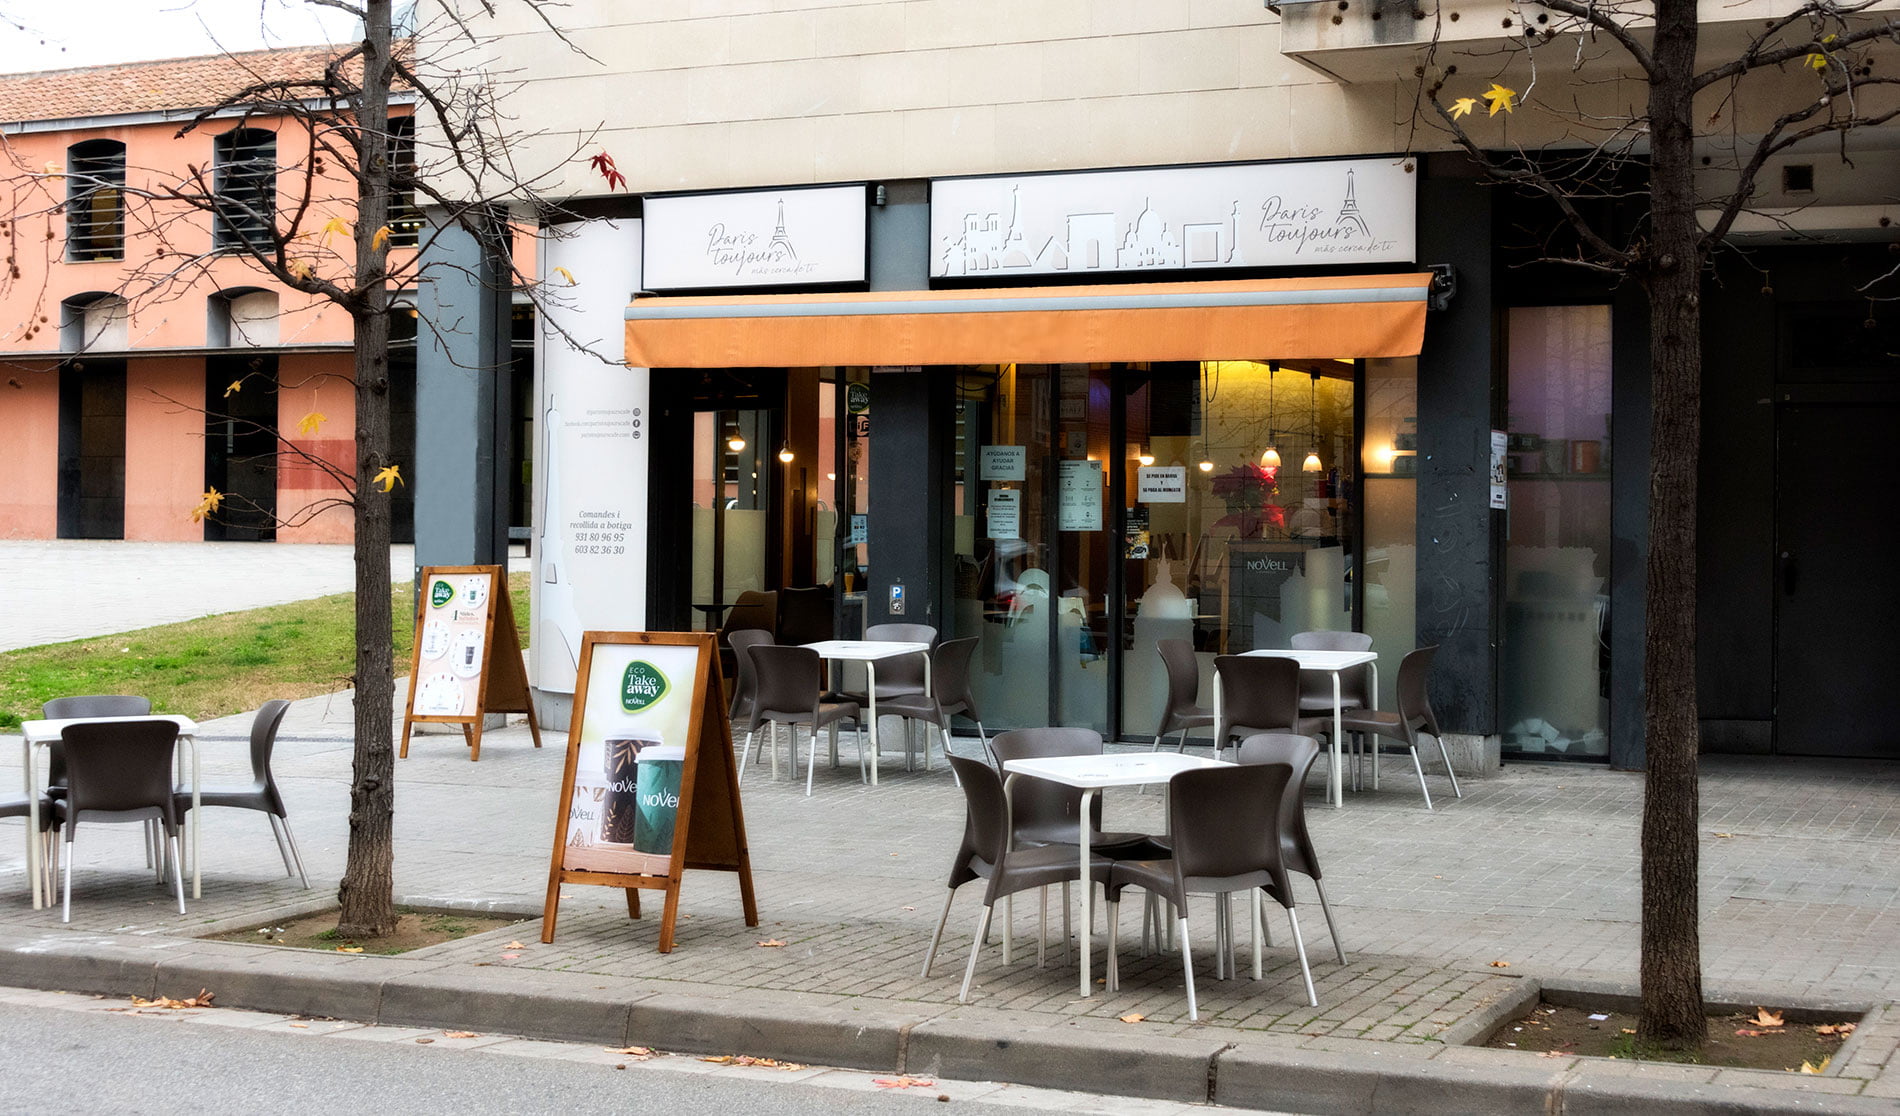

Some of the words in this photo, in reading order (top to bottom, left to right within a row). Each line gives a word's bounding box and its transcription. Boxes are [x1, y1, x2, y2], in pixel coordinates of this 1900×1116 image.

[1260, 195, 1323, 231] Paris
[707, 223, 758, 255] Paris
[1264, 221, 1357, 254] toujours
[711, 246, 786, 275] toujours
[578, 510, 616, 519] Comandes
[616, 510, 621, 519] i
[569, 520, 599, 529] recollida
[606, 521, 633, 531] botiga
[575, 532, 588, 542] 931
[589, 532, 600, 542] 80
[600, 533, 612, 542] 96
[613, 532, 625, 542] 95
[574, 545, 588, 554] 603
[589, 545, 600, 554] 82
[600, 545, 612, 555] 36
[613, 545, 625, 555] 30
[892, 586, 901, 598] P
[628, 674, 657, 686] Take
[626, 684, 660, 698] away
